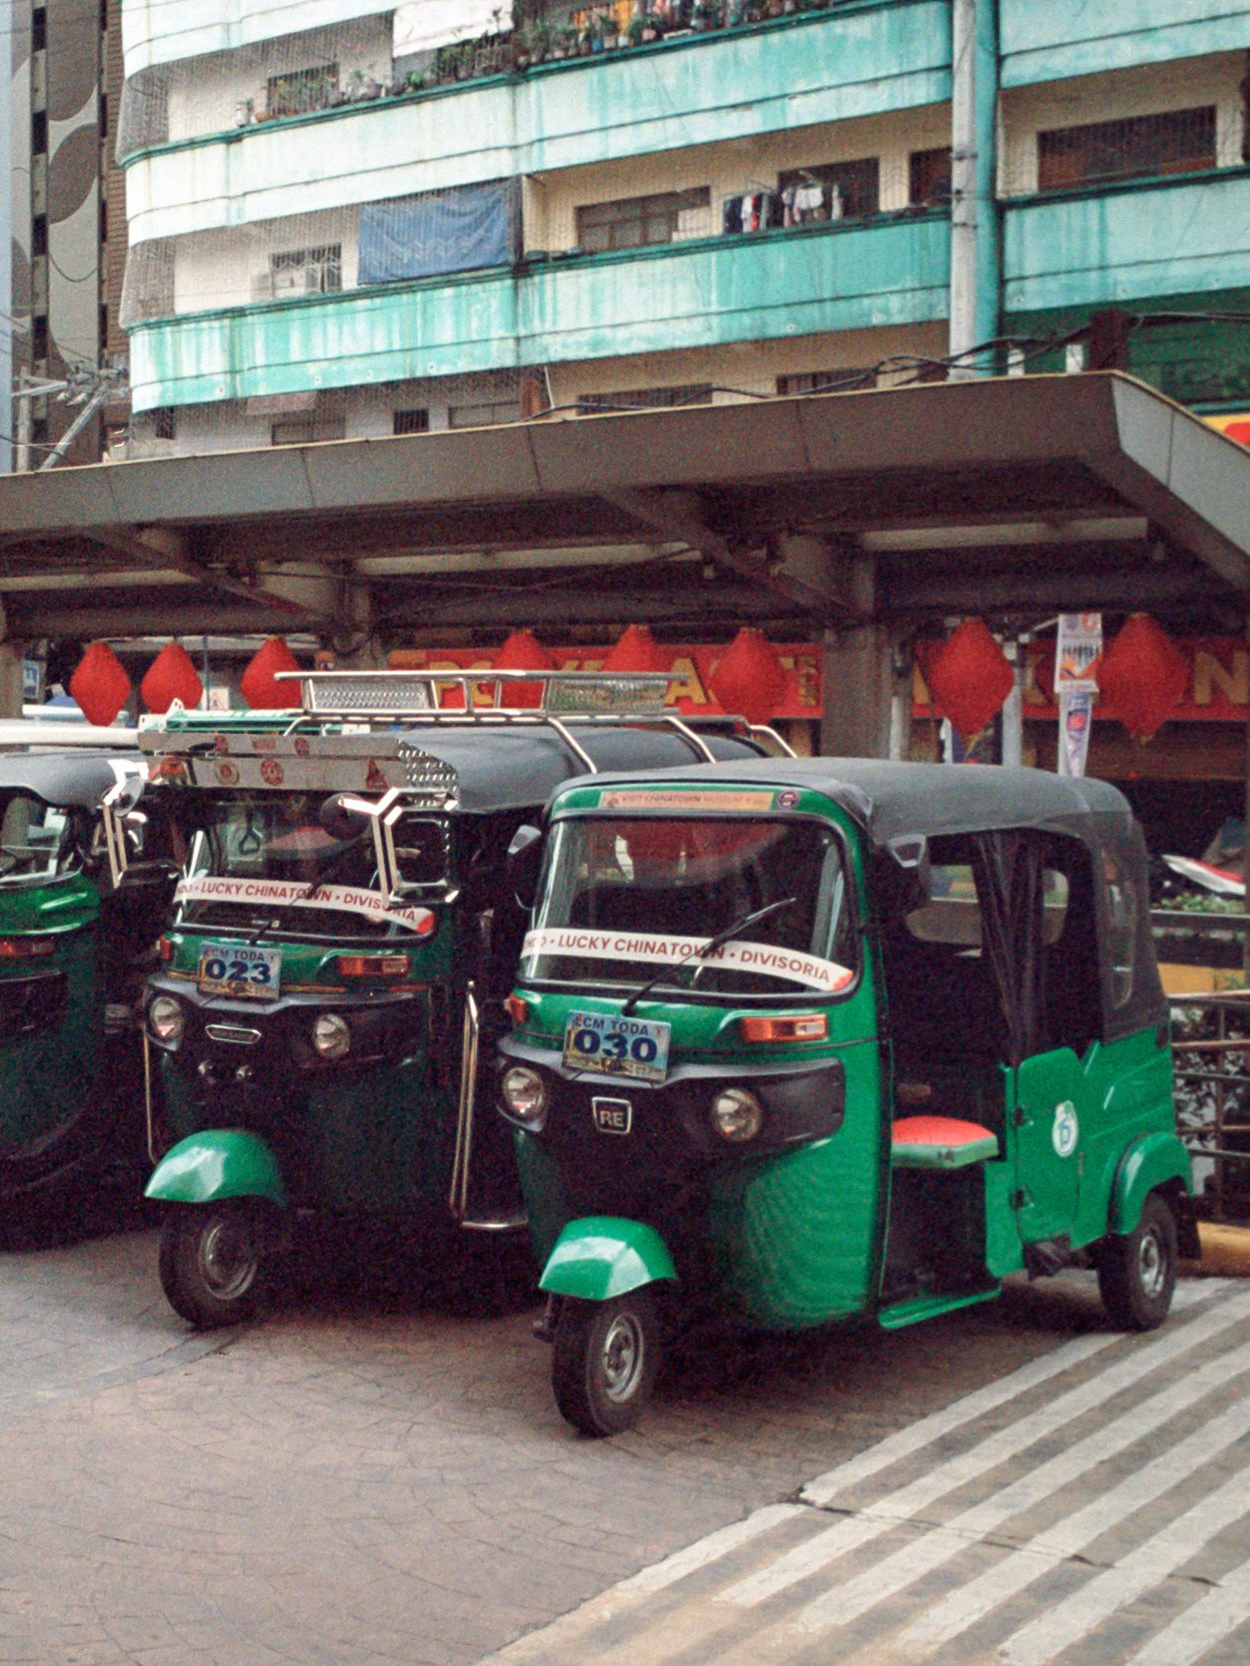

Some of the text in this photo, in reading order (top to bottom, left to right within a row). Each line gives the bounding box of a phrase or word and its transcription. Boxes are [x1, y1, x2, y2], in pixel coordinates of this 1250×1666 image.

[200, 882, 243, 896] LUCKY
[343, 892, 416, 922] DIVISIA
[233, 950, 265, 962] TODA
[558, 936, 611, 951] LUCKY
[613, 938, 725, 960] CHINATOWN
[739, 950, 830, 983] DIVISORIA
[205, 959, 271, 985] 023
[610, 1020, 649, 1036] TODA
[573, 1029, 658, 1062] 030
[599, 1110, 624, 1127] RE
